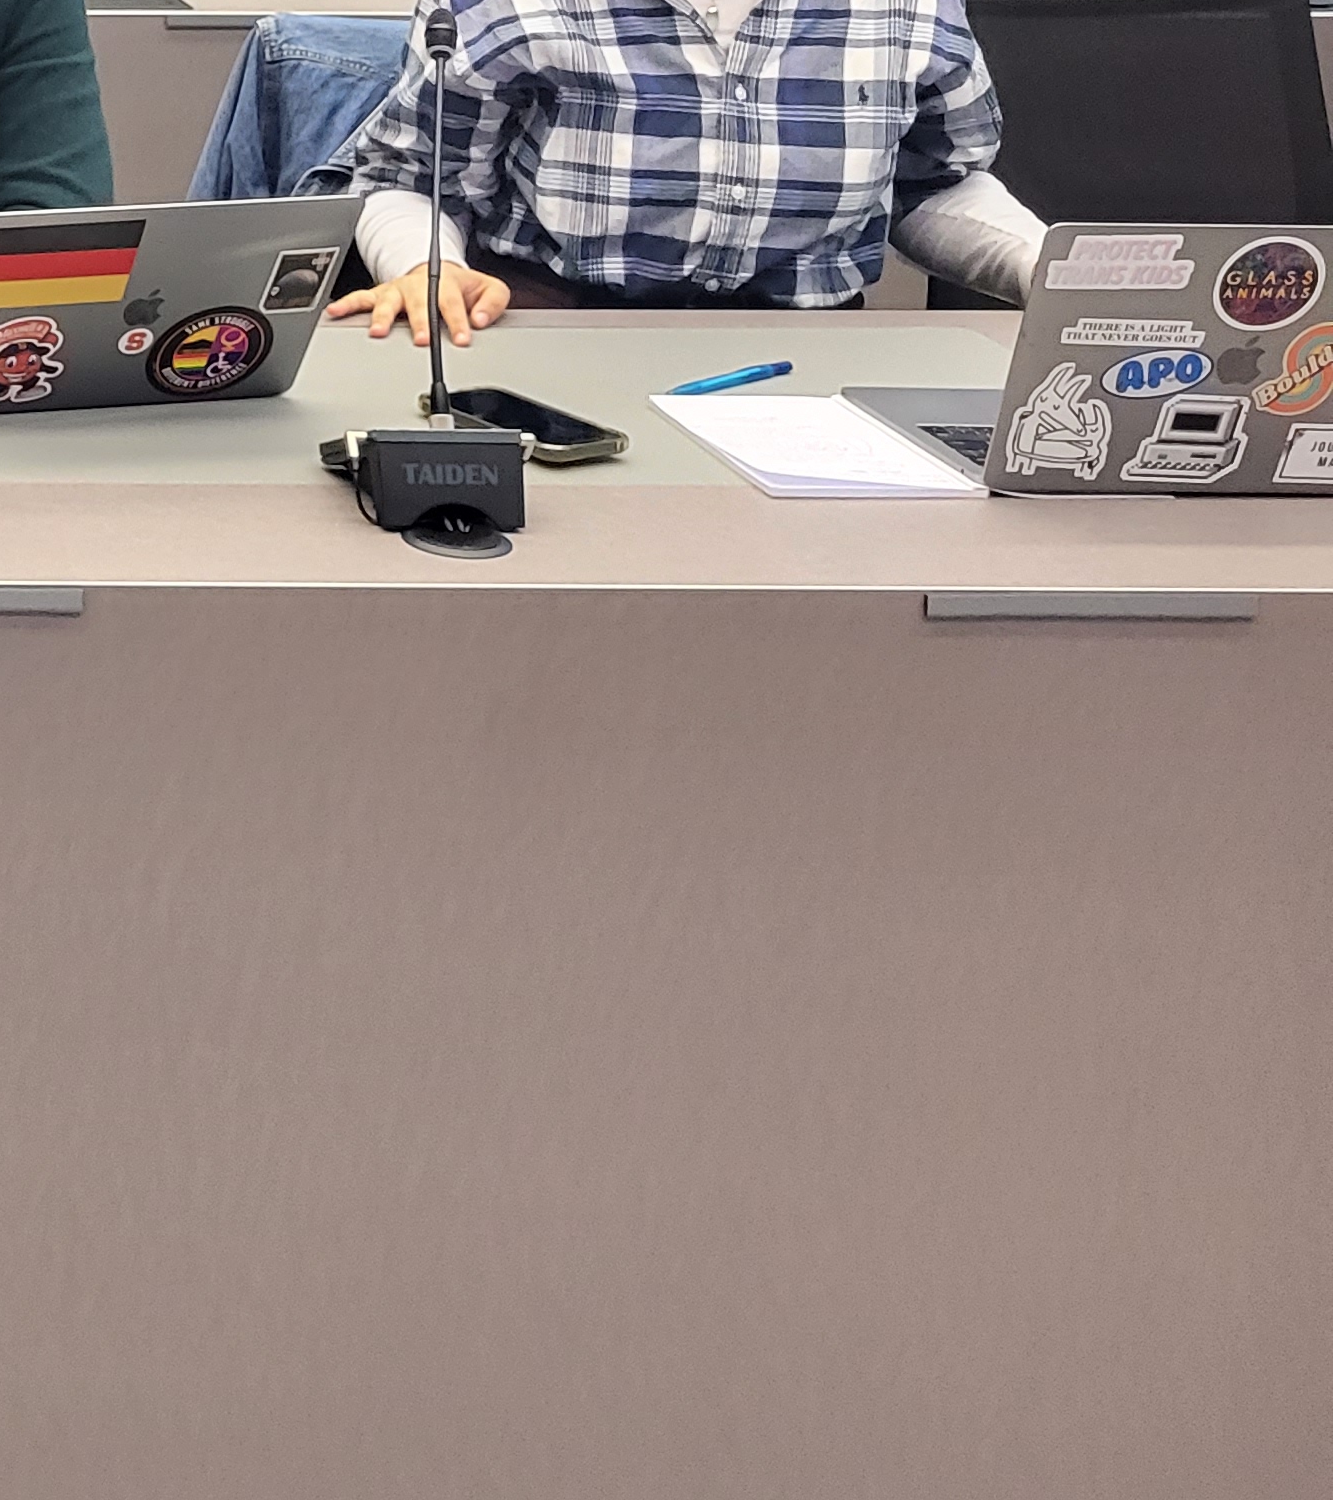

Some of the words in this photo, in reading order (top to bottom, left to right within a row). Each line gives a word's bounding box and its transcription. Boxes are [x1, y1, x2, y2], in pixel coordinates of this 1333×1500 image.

[1074, 238, 1178, 261] PROTECT
[1051, 264, 1128, 285] TRANS
[1130, 264, 1189, 285] KIDS
[1226, 270, 1314, 286] GLASS
[1222, 286, 1311, 300] ANIMALS
[1081, 322, 1122, 332] THERE
[1124, 323, 1135, 332] IS
[1148, 324, 1186, 334] LIGHT
[1065, 331, 1097, 341] THAT
[1100, 332, 1140, 342] NEVER
[1142, 333, 1173, 343] GOES
[1174, 334, 1199, 344] OUT
[1115, 353, 1203, 393] APO
[402, 462, 499, 486] TAIDEN
